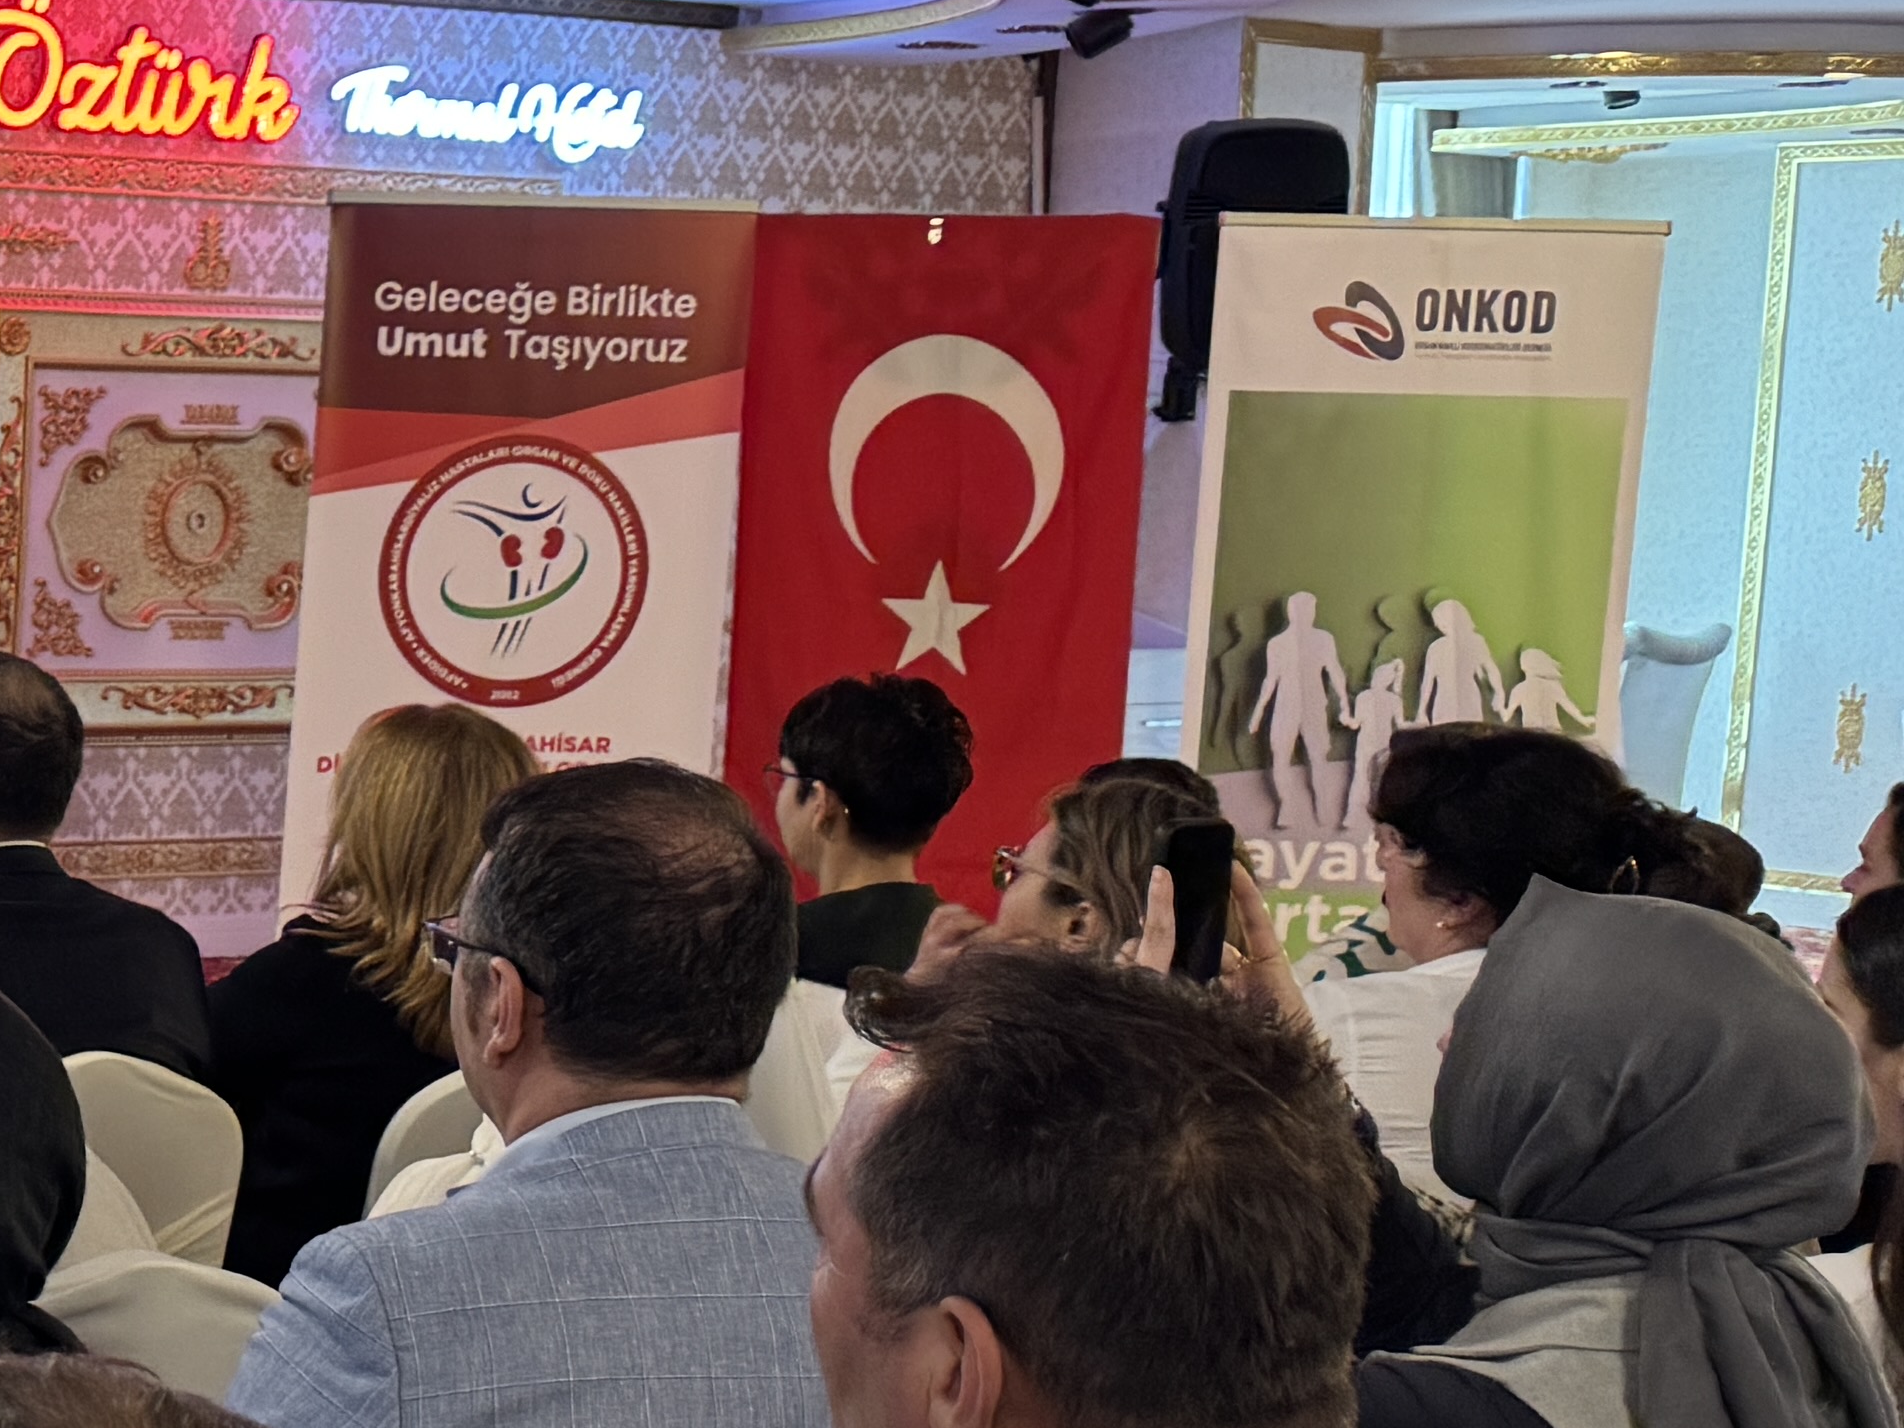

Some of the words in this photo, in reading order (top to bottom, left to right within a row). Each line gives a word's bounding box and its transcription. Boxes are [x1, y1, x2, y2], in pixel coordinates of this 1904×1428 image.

[374, 281, 557, 323] Geleceğe
[566, 285, 697, 318] Birlikte
[1415, 288, 1557, 334] ONKOD
[377, 326, 487, 358] Umut
[504, 328, 689, 371] Taşıyoruz
[1247, 831, 1379, 888] ayat
